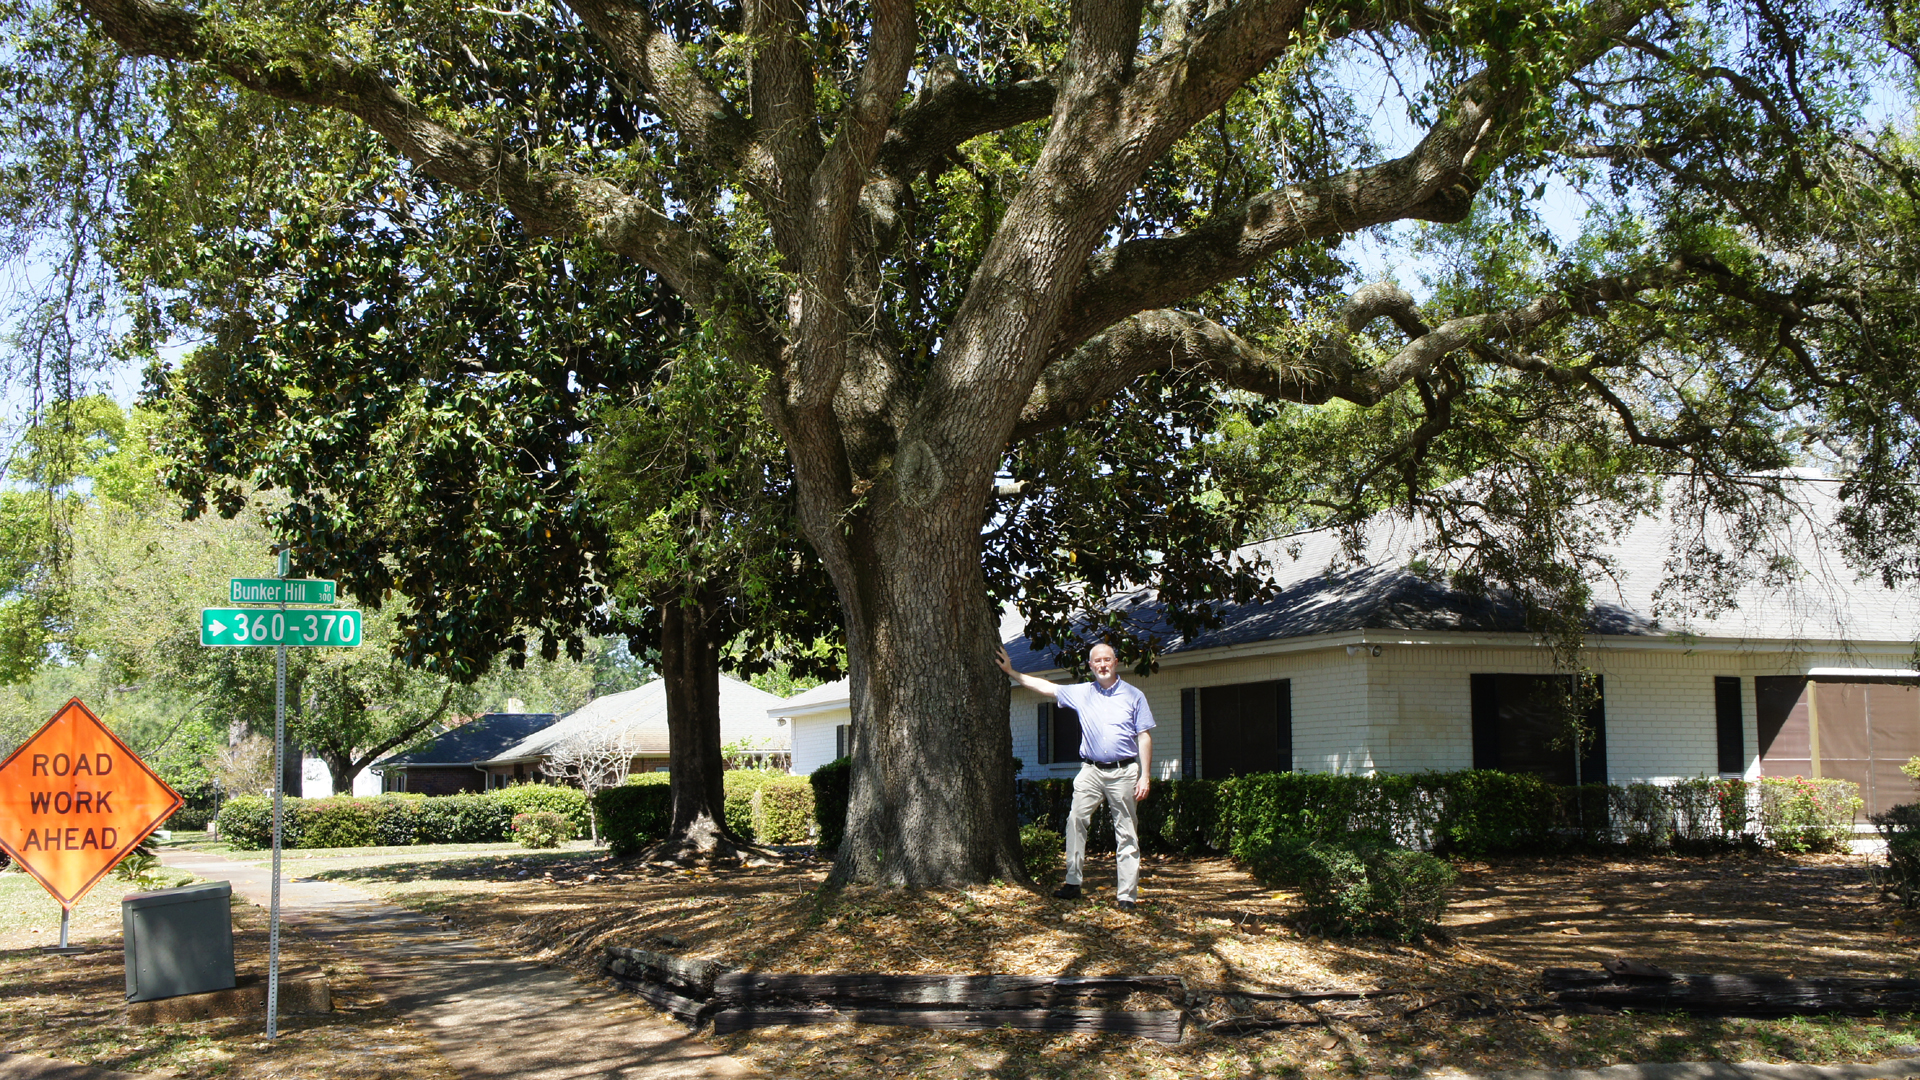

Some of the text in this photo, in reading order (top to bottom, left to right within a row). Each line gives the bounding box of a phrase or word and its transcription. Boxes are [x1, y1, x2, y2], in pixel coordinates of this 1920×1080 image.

[233, 582, 306, 601] Bunker Hill
[318, 593, 332, 602] 300
[324, 584, 331, 593] Dr
[233, 613, 355, 642] 360-370
[32, 753, 113, 777] ROAD
[30, 791, 113, 814] WORK
[22, 827, 118, 851] AHEAD
